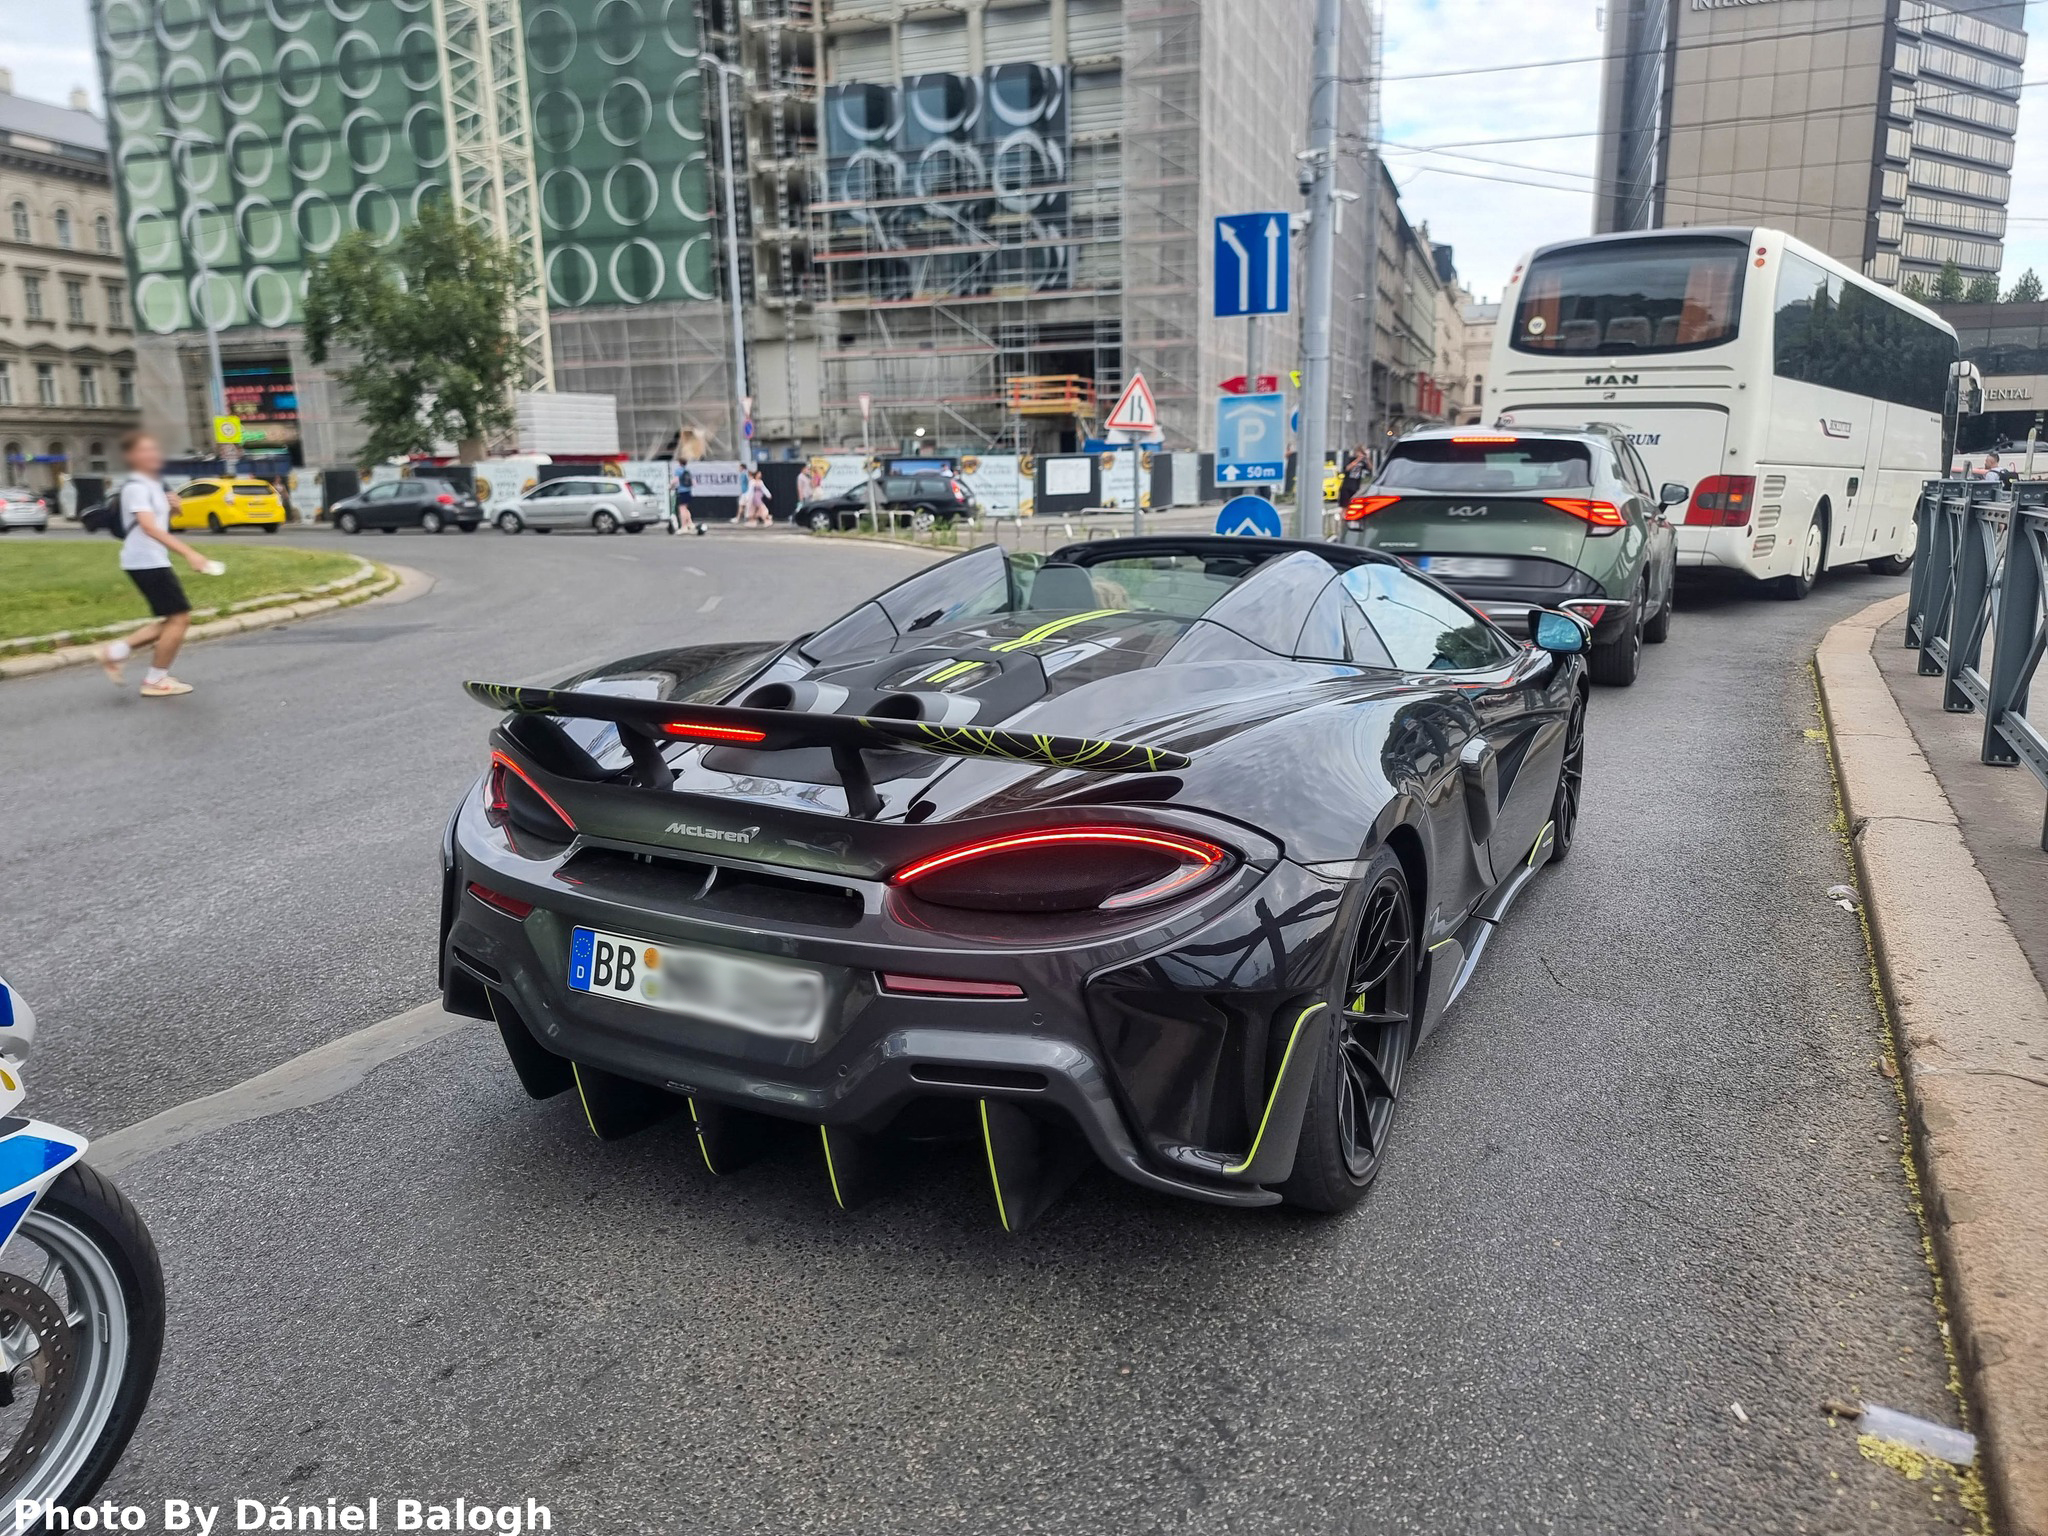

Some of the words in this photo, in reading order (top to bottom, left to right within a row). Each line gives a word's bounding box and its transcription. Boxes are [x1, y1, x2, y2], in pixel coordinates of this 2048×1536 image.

[1585, 374, 1639, 385] MAN
[1238, 418, 1266, 458] P
[1624, 433, 1662, 446] RUM
[1448, 505, 1487, 517] KIA
[664, 822, 750, 844] McLaren
[576, 965, 585, 979] D
[593, 940, 637, 992] BB
